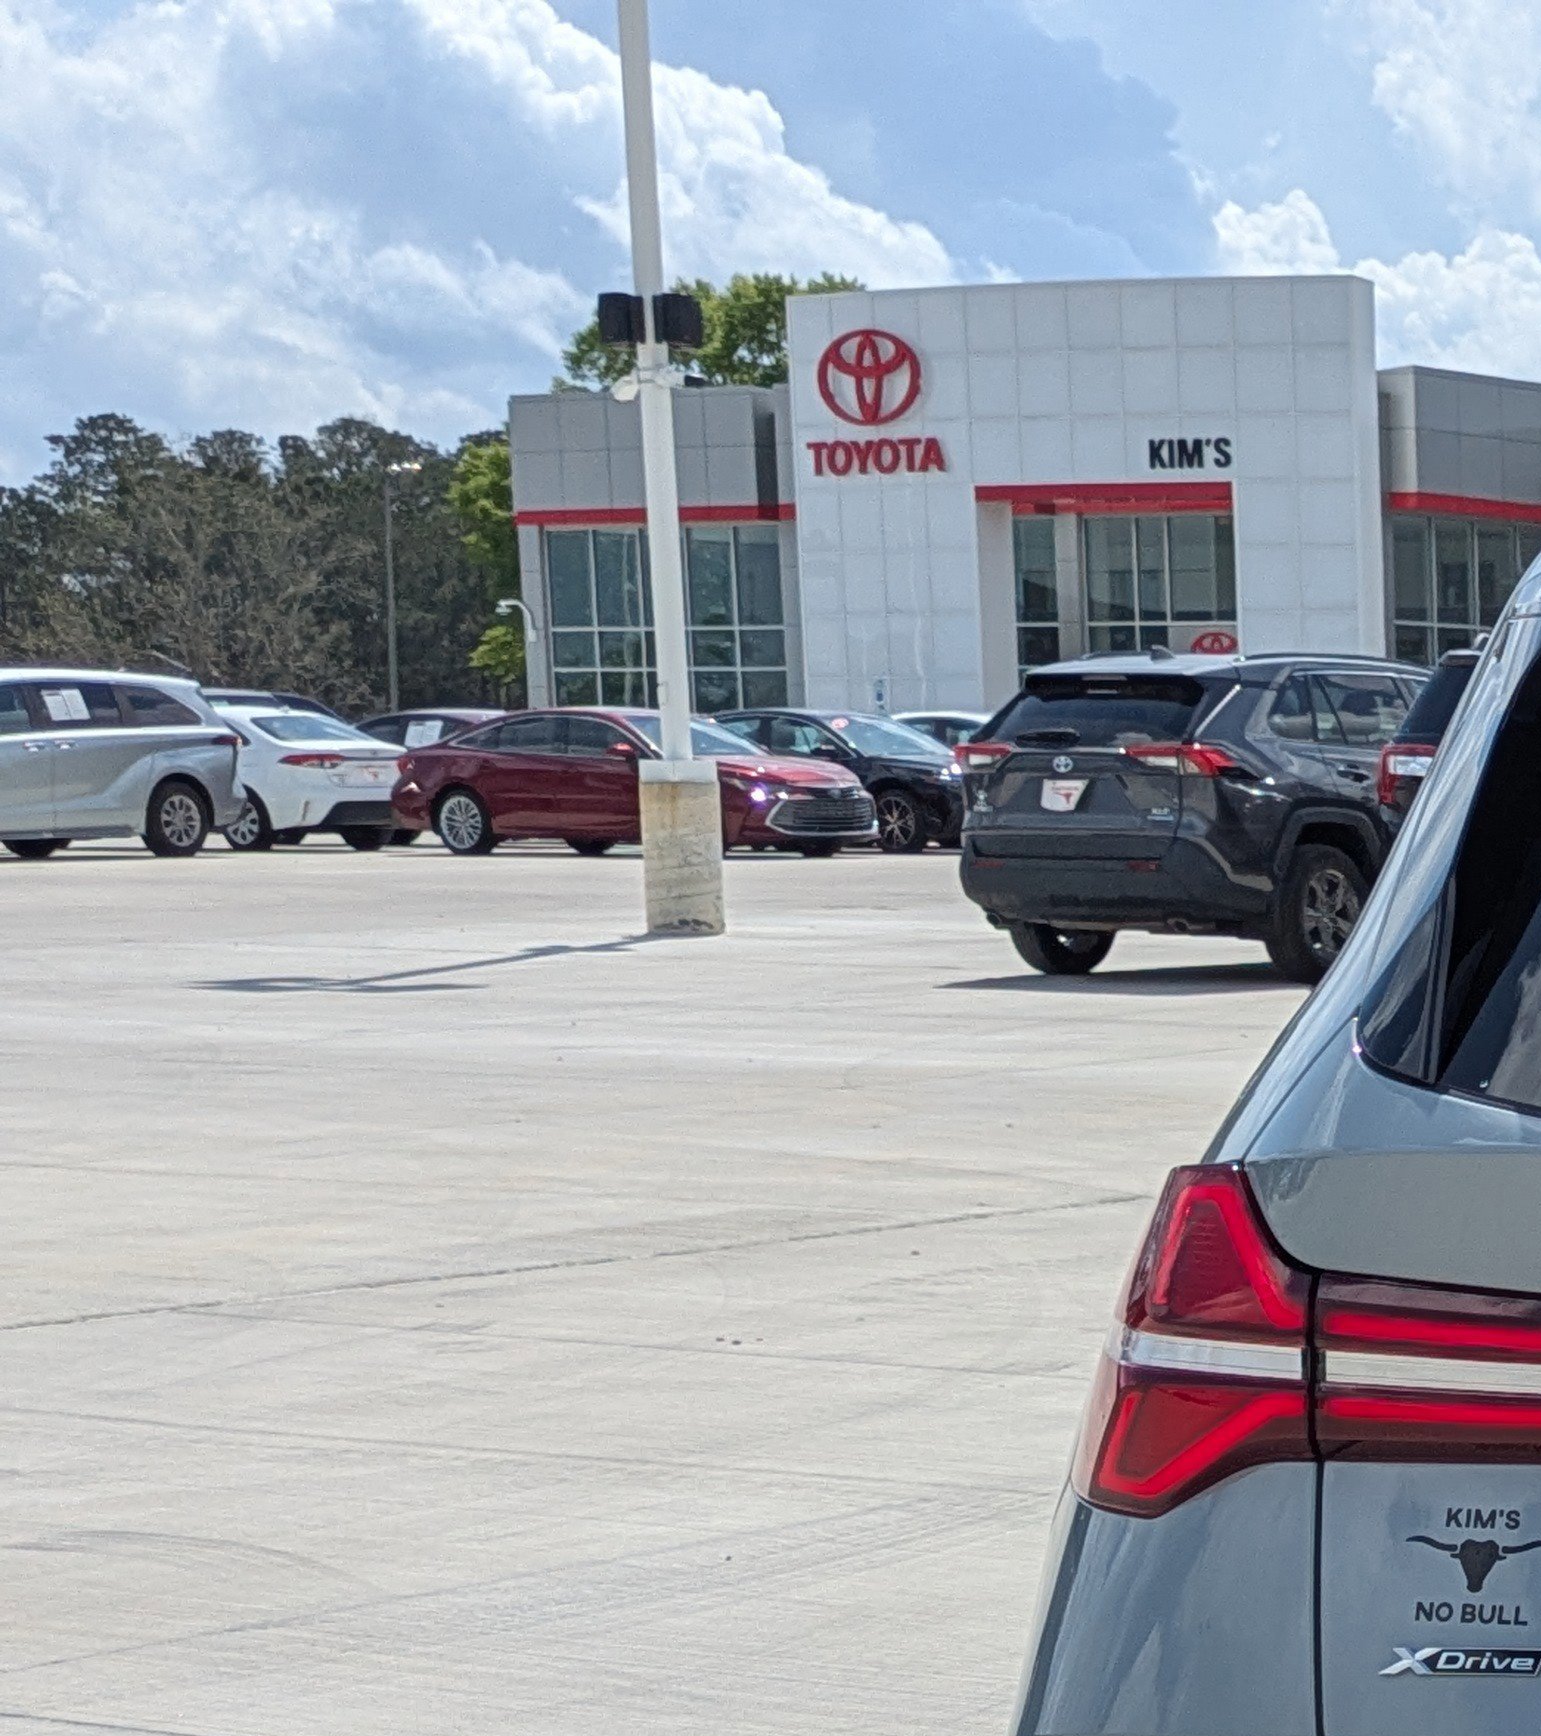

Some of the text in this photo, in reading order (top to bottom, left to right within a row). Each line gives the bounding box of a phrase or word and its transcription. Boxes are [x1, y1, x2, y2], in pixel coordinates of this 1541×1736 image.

[806, 437, 946, 477] TOYOTA
[1148, 437, 1232, 469] KIM'S
[1445, 1507, 1520, 1530] KIM'S
[1414, 1601, 1528, 1626] NO BULL
